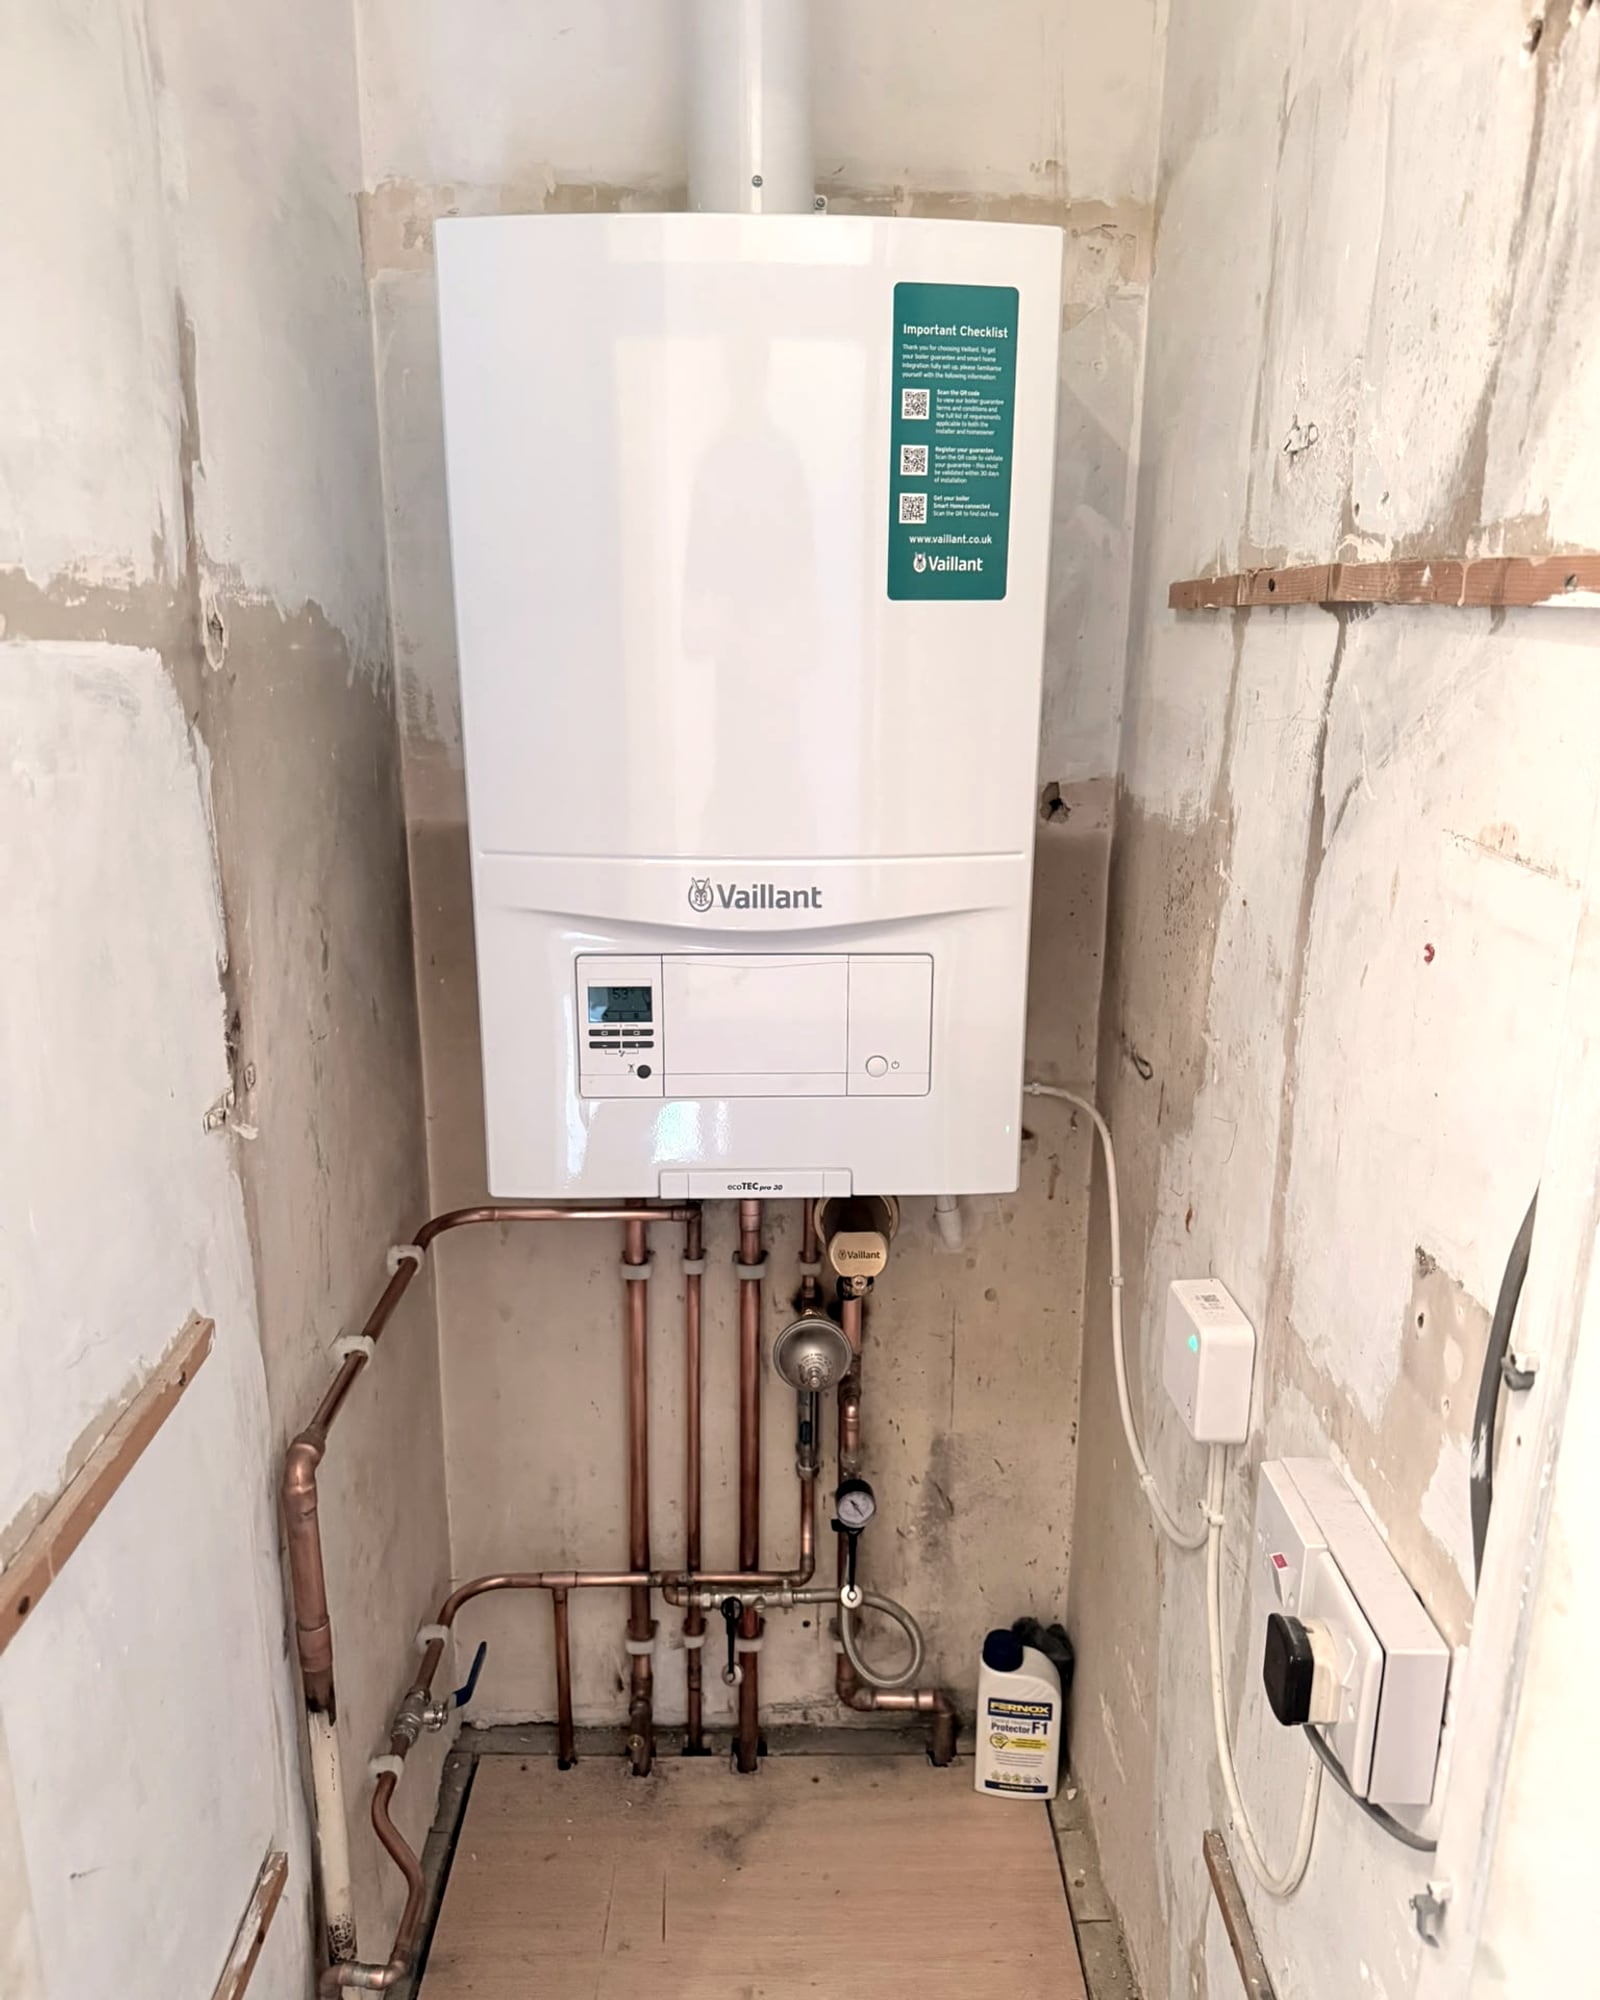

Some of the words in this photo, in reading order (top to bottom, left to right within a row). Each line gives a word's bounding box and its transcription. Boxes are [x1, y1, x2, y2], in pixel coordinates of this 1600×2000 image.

[903, 323, 956, 337] Important
[960, 325, 1008, 338] Checklist
[908, 534, 992, 544] www.vaillant.co.uk
[928, 556, 984, 572] Vaillant
[716, 884, 823, 909] Vaillant
[727, 1182, 759, 1191] ecoTEC
[847, 1250, 880, 1259] Vaillant
[991, 1722, 1030, 1734] Protector
[1032, 1722, 1048, 1735] F1
